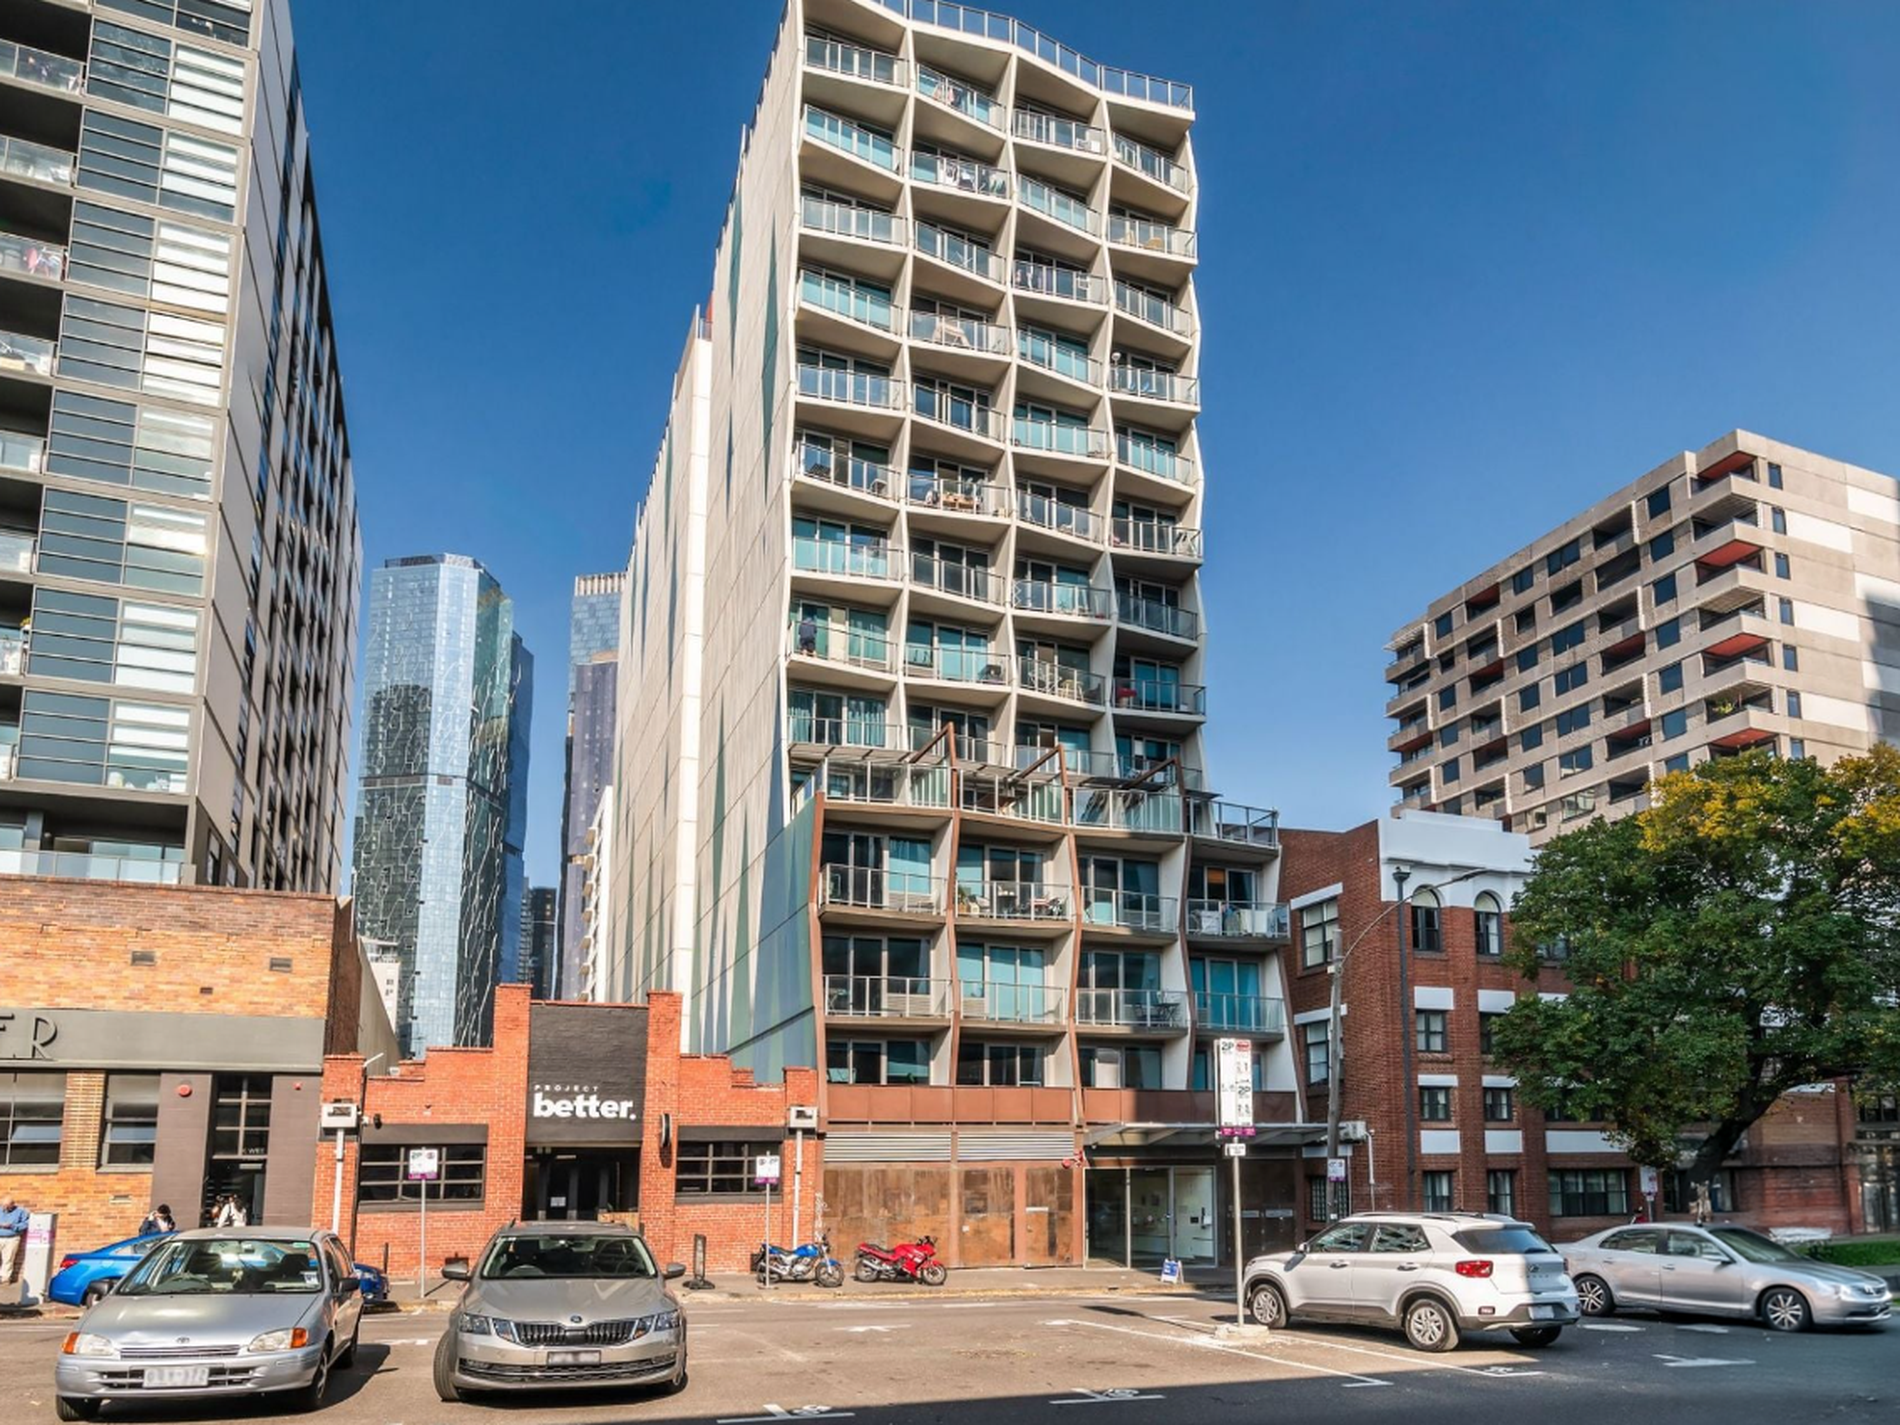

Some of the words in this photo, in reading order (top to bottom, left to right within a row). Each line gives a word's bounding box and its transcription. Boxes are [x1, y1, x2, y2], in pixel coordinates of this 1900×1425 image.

[1222, 1041, 1234, 1050] 2P
[534, 1084, 598, 1092] PROJECT
[1238, 1085, 1250, 1095] 2P
[533, 1092, 636, 1120] better.
